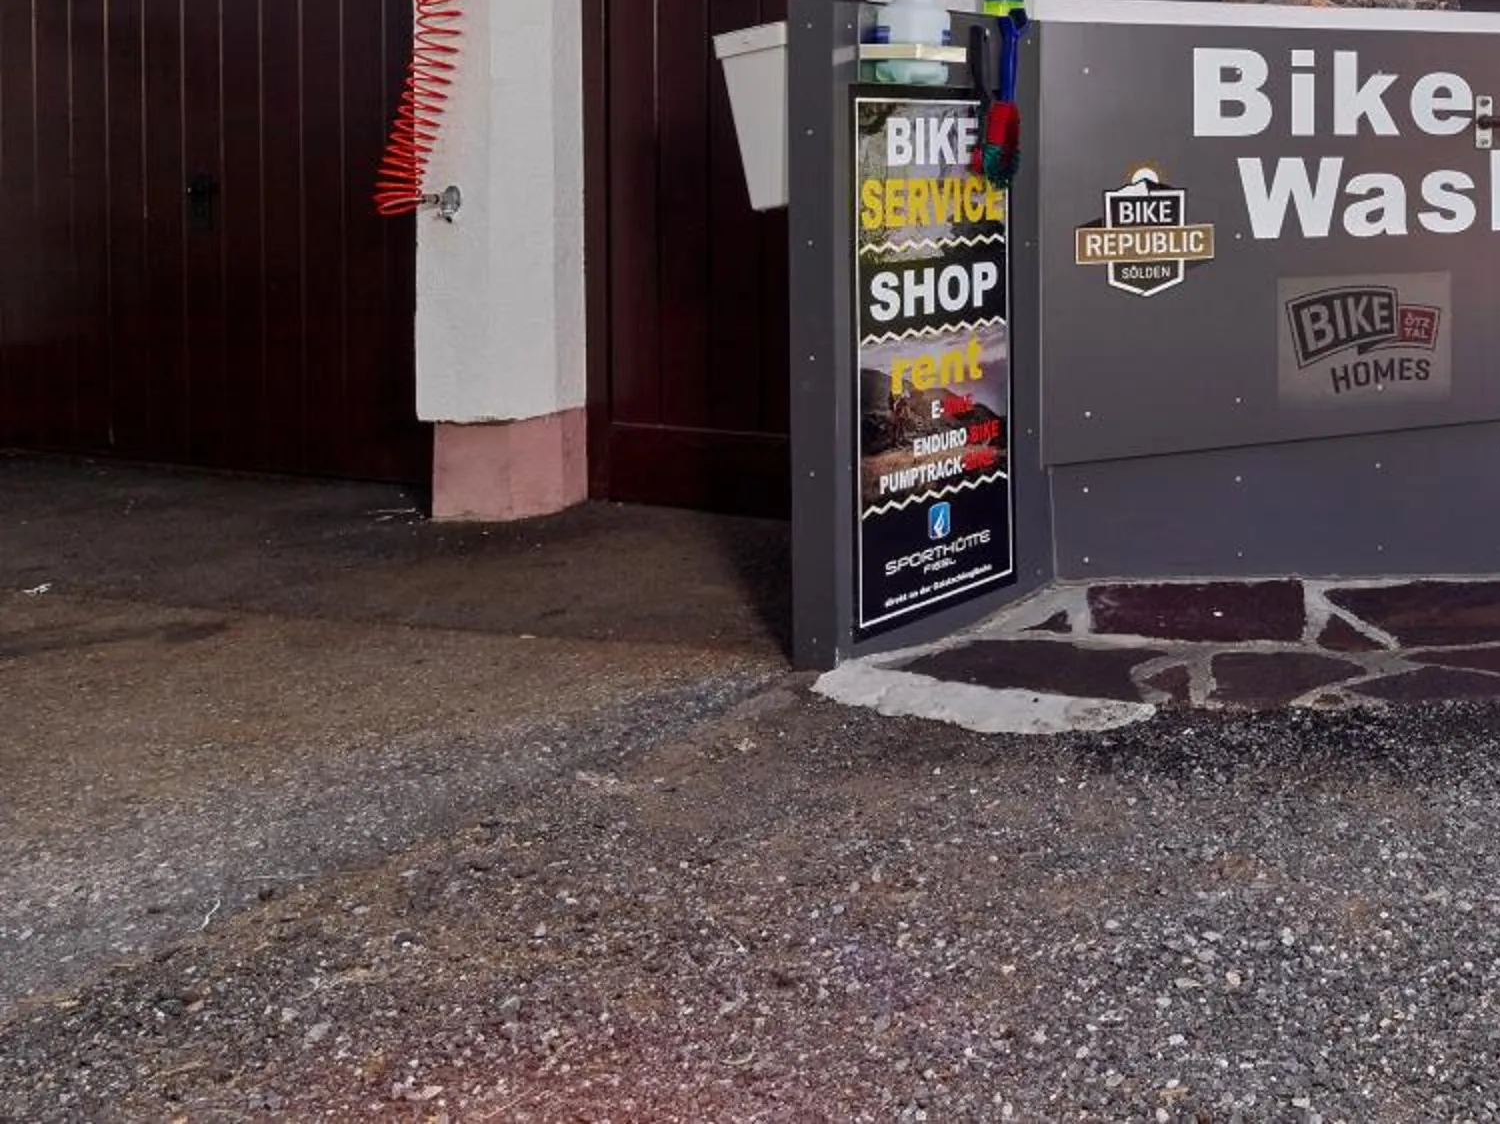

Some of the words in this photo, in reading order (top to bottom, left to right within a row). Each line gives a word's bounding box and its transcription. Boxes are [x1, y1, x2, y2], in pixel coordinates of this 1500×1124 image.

[1193, 47, 1474, 137] Bike
[886, 116, 979, 167] BIKE
[861, 175, 1006, 230] SERVICE
[1119, 200, 1173, 224] BIKE
[1085, 230, 1205, 257] REPUBLIC
[869, 261, 998, 323] SHOP
[1121, 264, 1172, 280] SÖLDEN
[1300, 295, 1392, 352] BIKE
[889, 332, 984, 396] rent
[1330, 357, 1432, 395] HOMES
[913, 427, 967, 457] ENDURO
